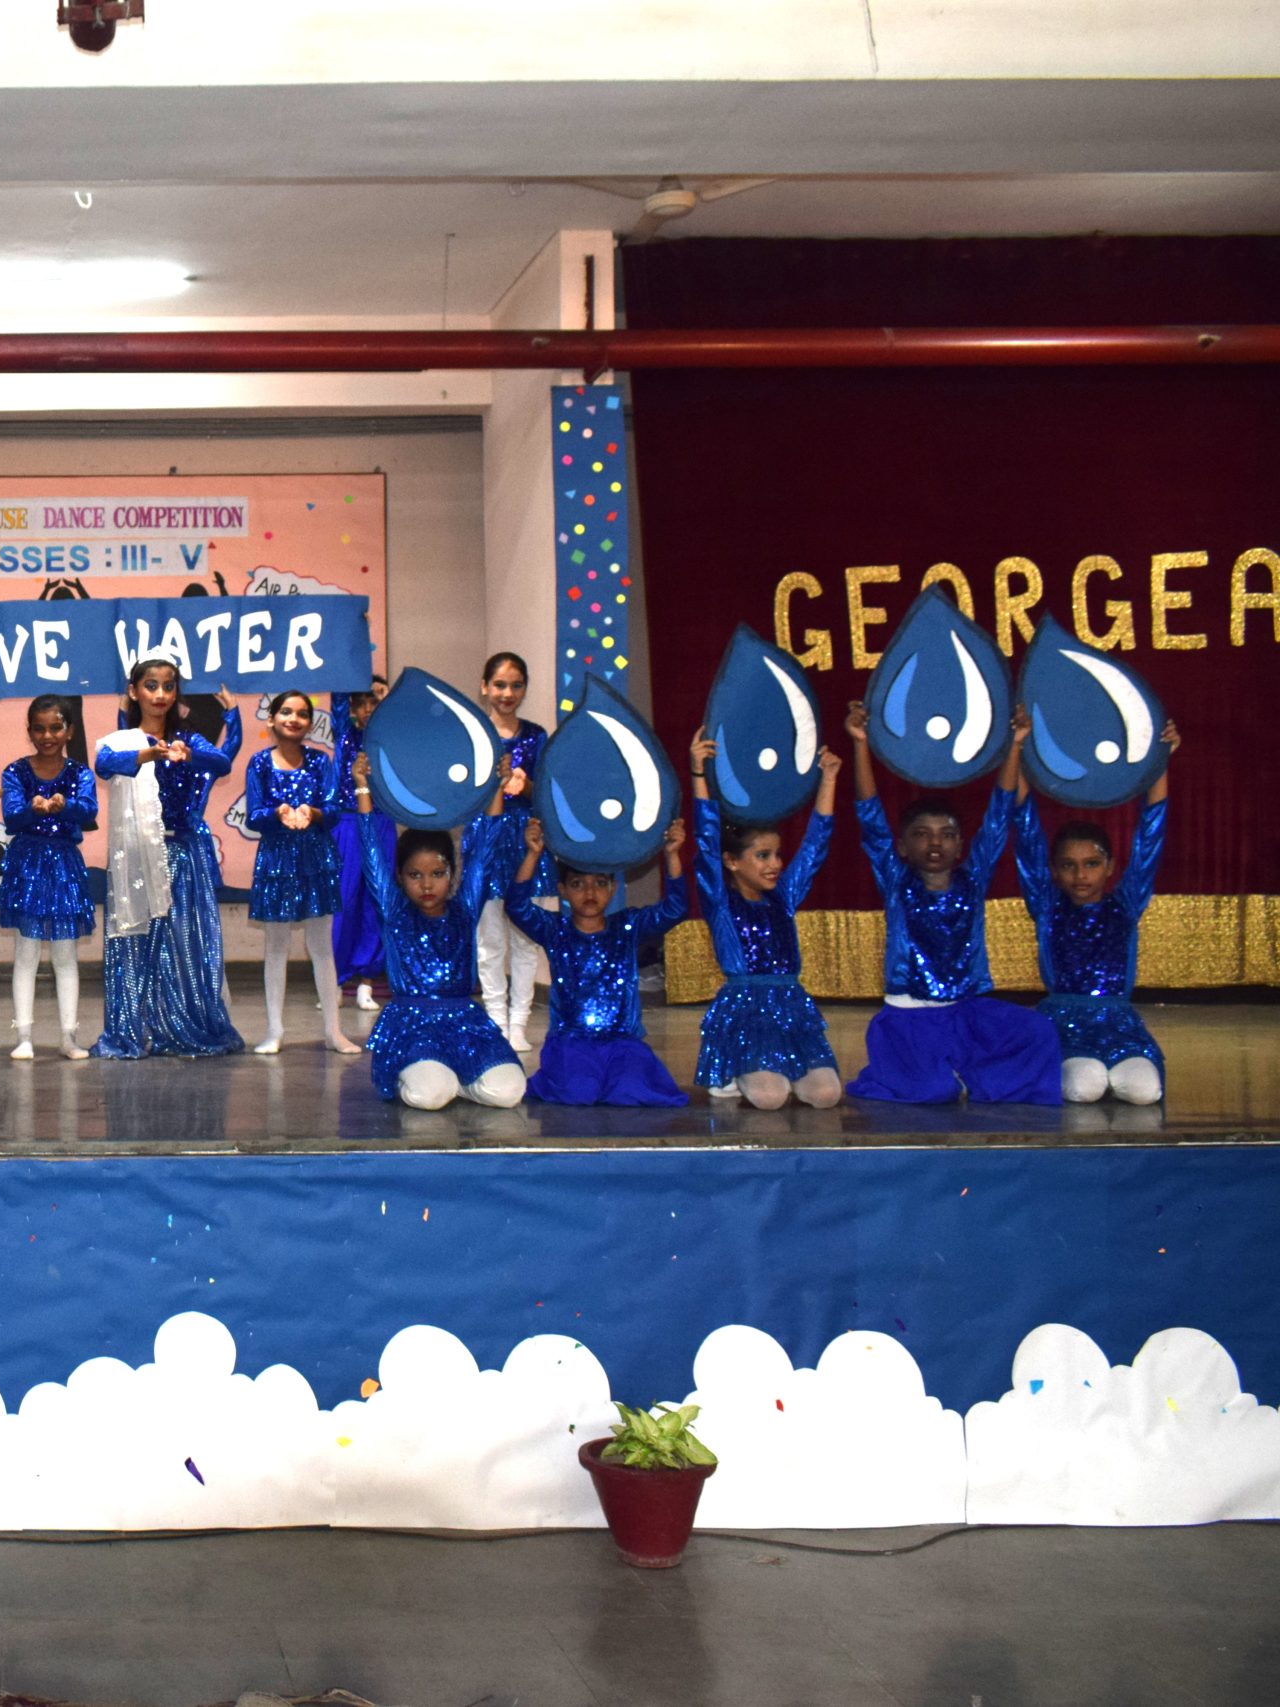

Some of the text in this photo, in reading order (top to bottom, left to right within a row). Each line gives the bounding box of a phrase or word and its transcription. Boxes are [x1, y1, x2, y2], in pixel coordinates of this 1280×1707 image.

[43, 507, 105, 529] DANCE
[113, 506, 244, 529] COMPETITION
[114, 610, 323, 680] WATER
